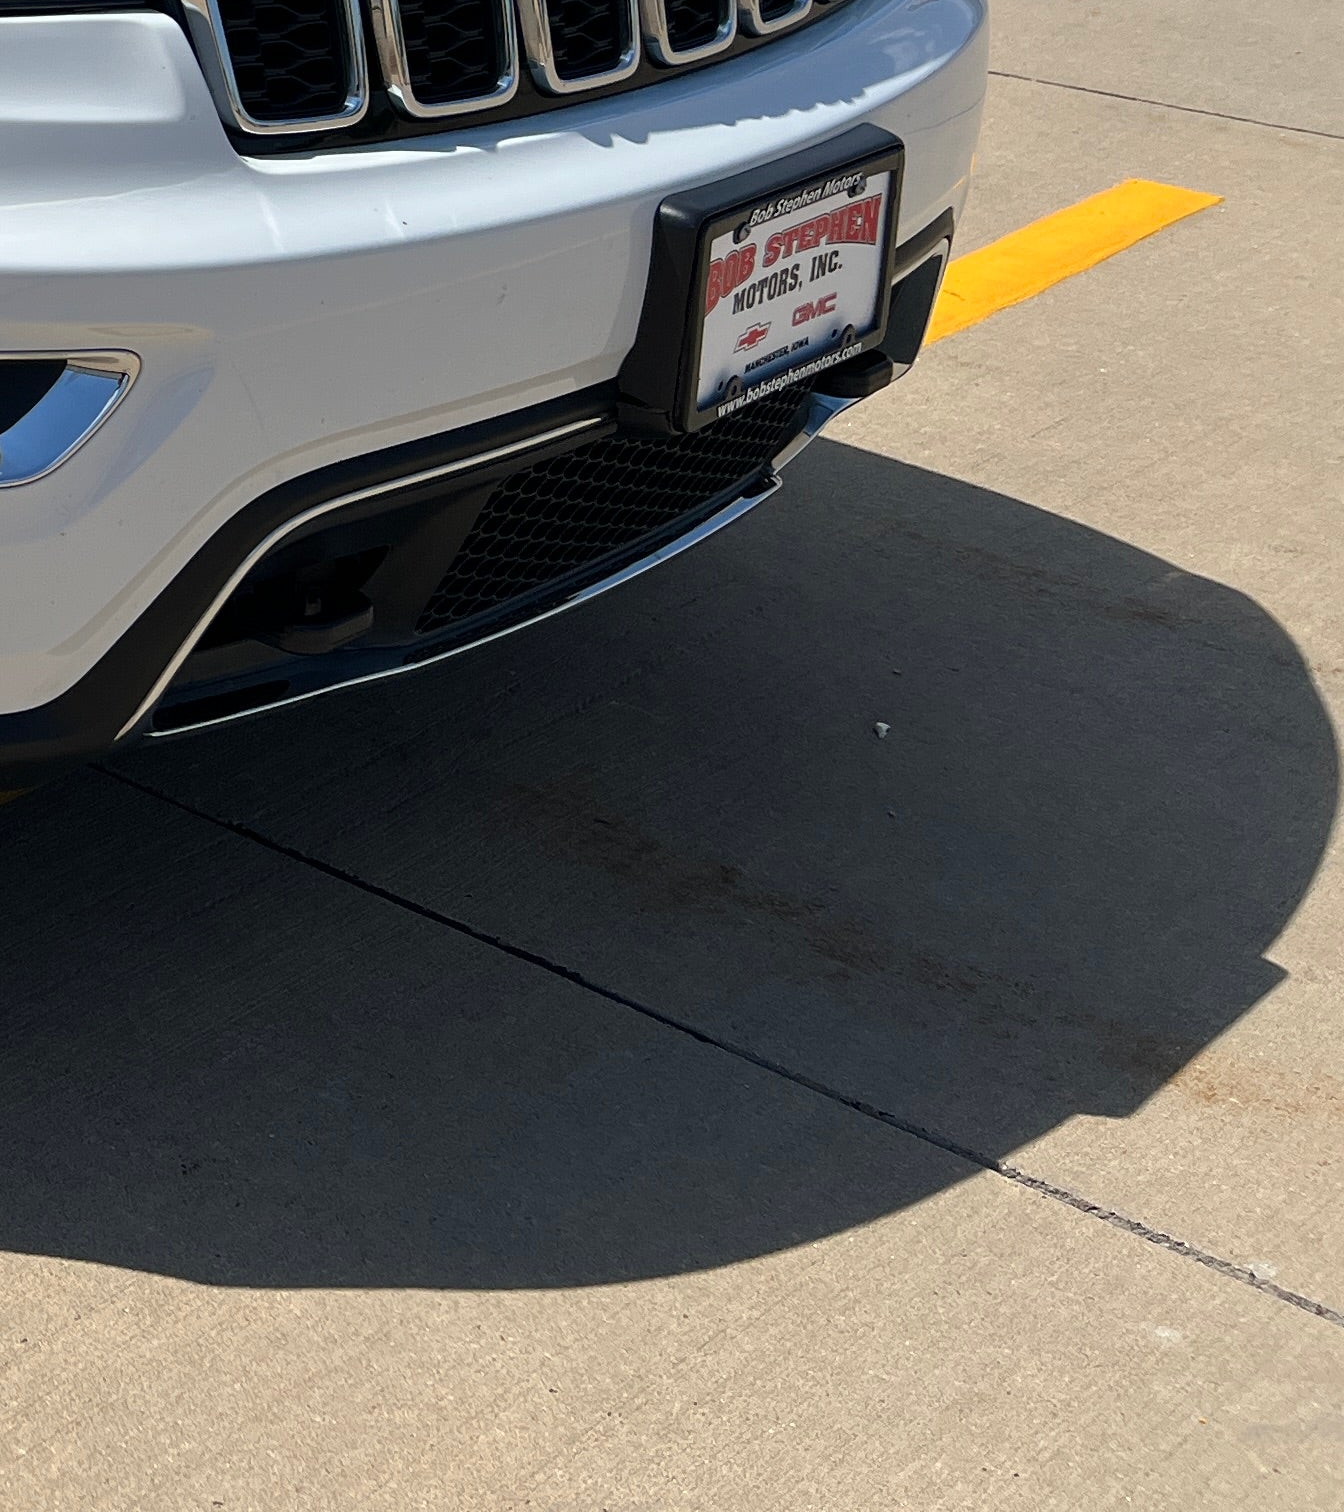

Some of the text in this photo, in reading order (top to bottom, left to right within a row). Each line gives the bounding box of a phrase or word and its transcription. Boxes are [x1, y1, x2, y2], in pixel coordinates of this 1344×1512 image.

[749, 173, 863, 226] Bob Stephen Motors
[704, 193, 883, 317] BOB STEPHEN
[732, 249, 843, 316] MOTORS, INC.
[791, 292, 838, 328] GMC
[716, 342, 863, 418] www.bobstephenmotors.com
